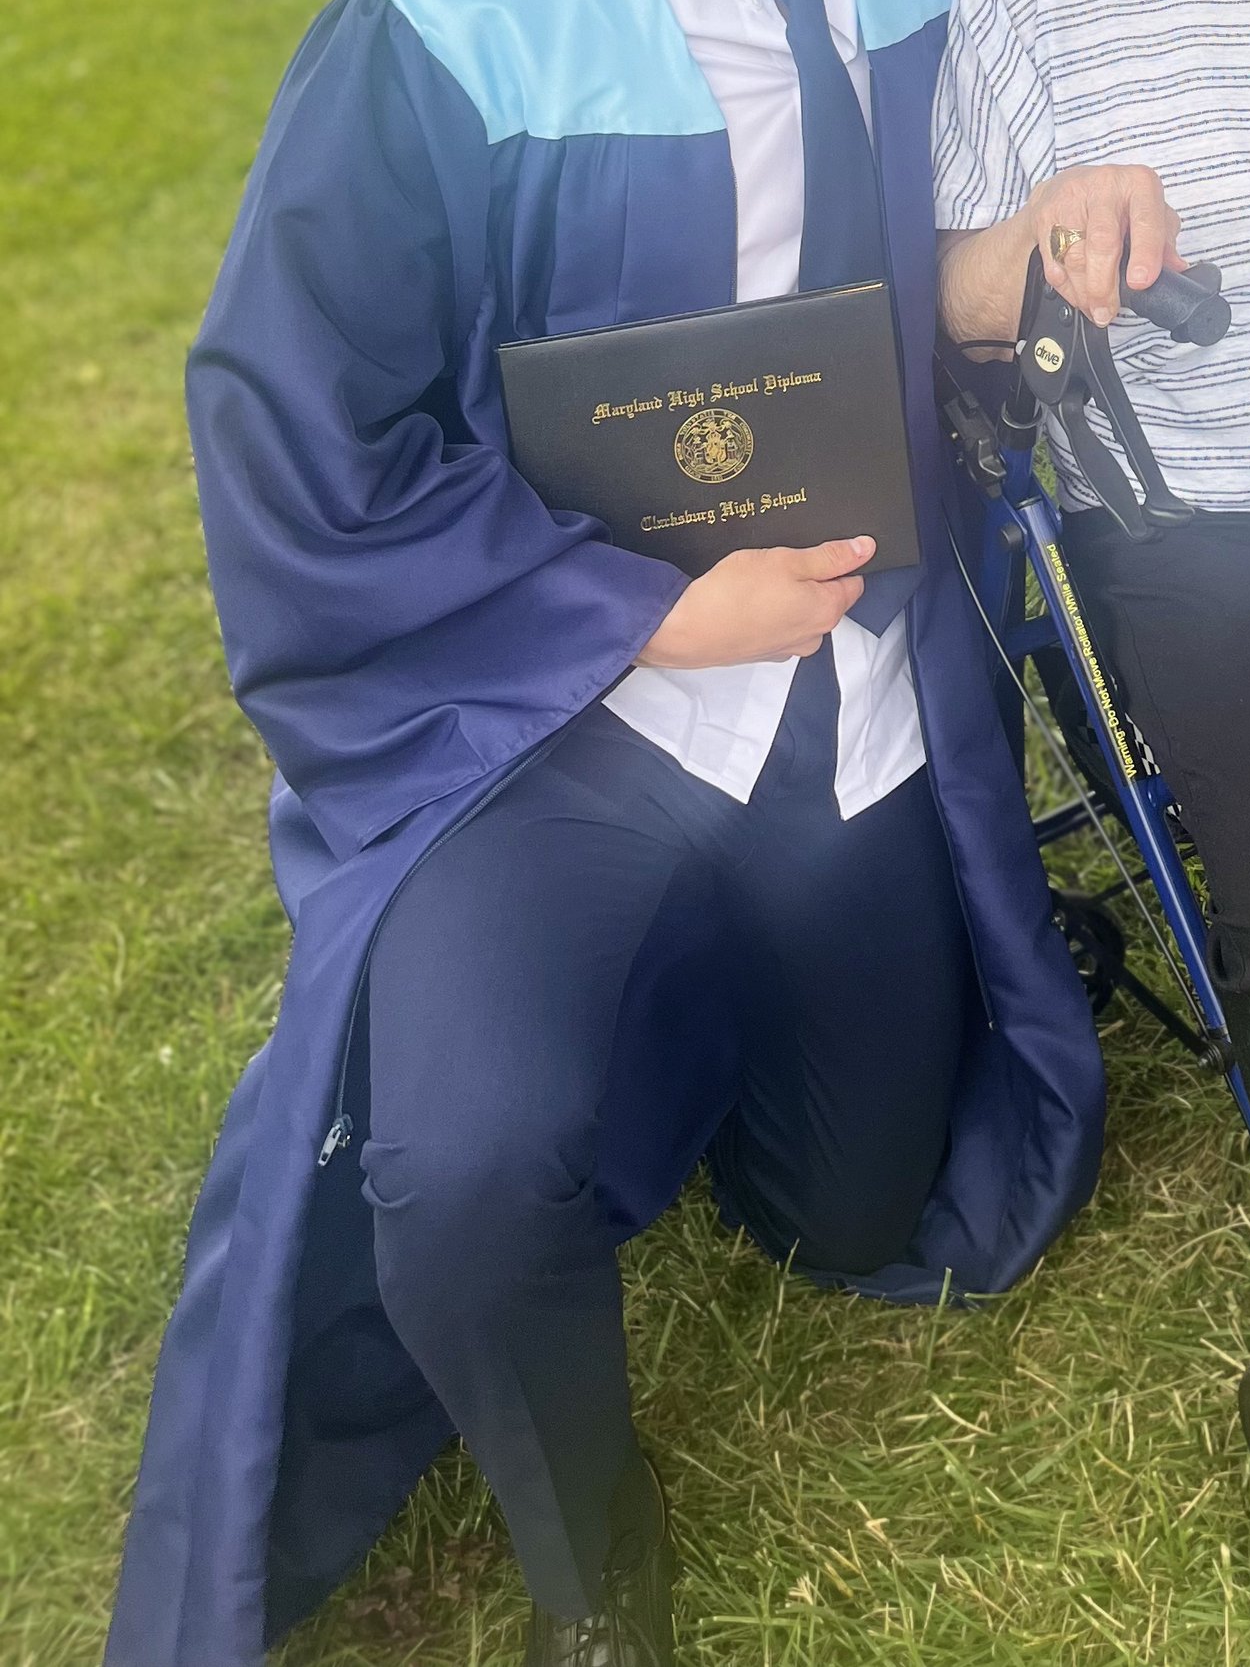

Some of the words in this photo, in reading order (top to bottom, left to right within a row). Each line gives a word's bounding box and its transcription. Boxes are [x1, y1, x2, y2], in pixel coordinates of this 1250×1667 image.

[1035, 345, 1060, 366] drive
[592, 396, 663, 425] Maryland
[667, 388, 704, 411] High
[710, 378, 758, 402] School
[763, 371, 822, 395] Diploma
[640, 509, 715, 532] Clarksburg
[719, 498, 755, 522] High
[760, 487, 807, 513] School
[1047, 543, 1067, 582] Seated
[1062, 583, 1078, 614] While
[1073, 615, 1094, 656] Rollator
[1089, 657, 1106, 688] Move
[1098, 688, 1113, 709] Not
[1107, 710, 1119, 727] Do
